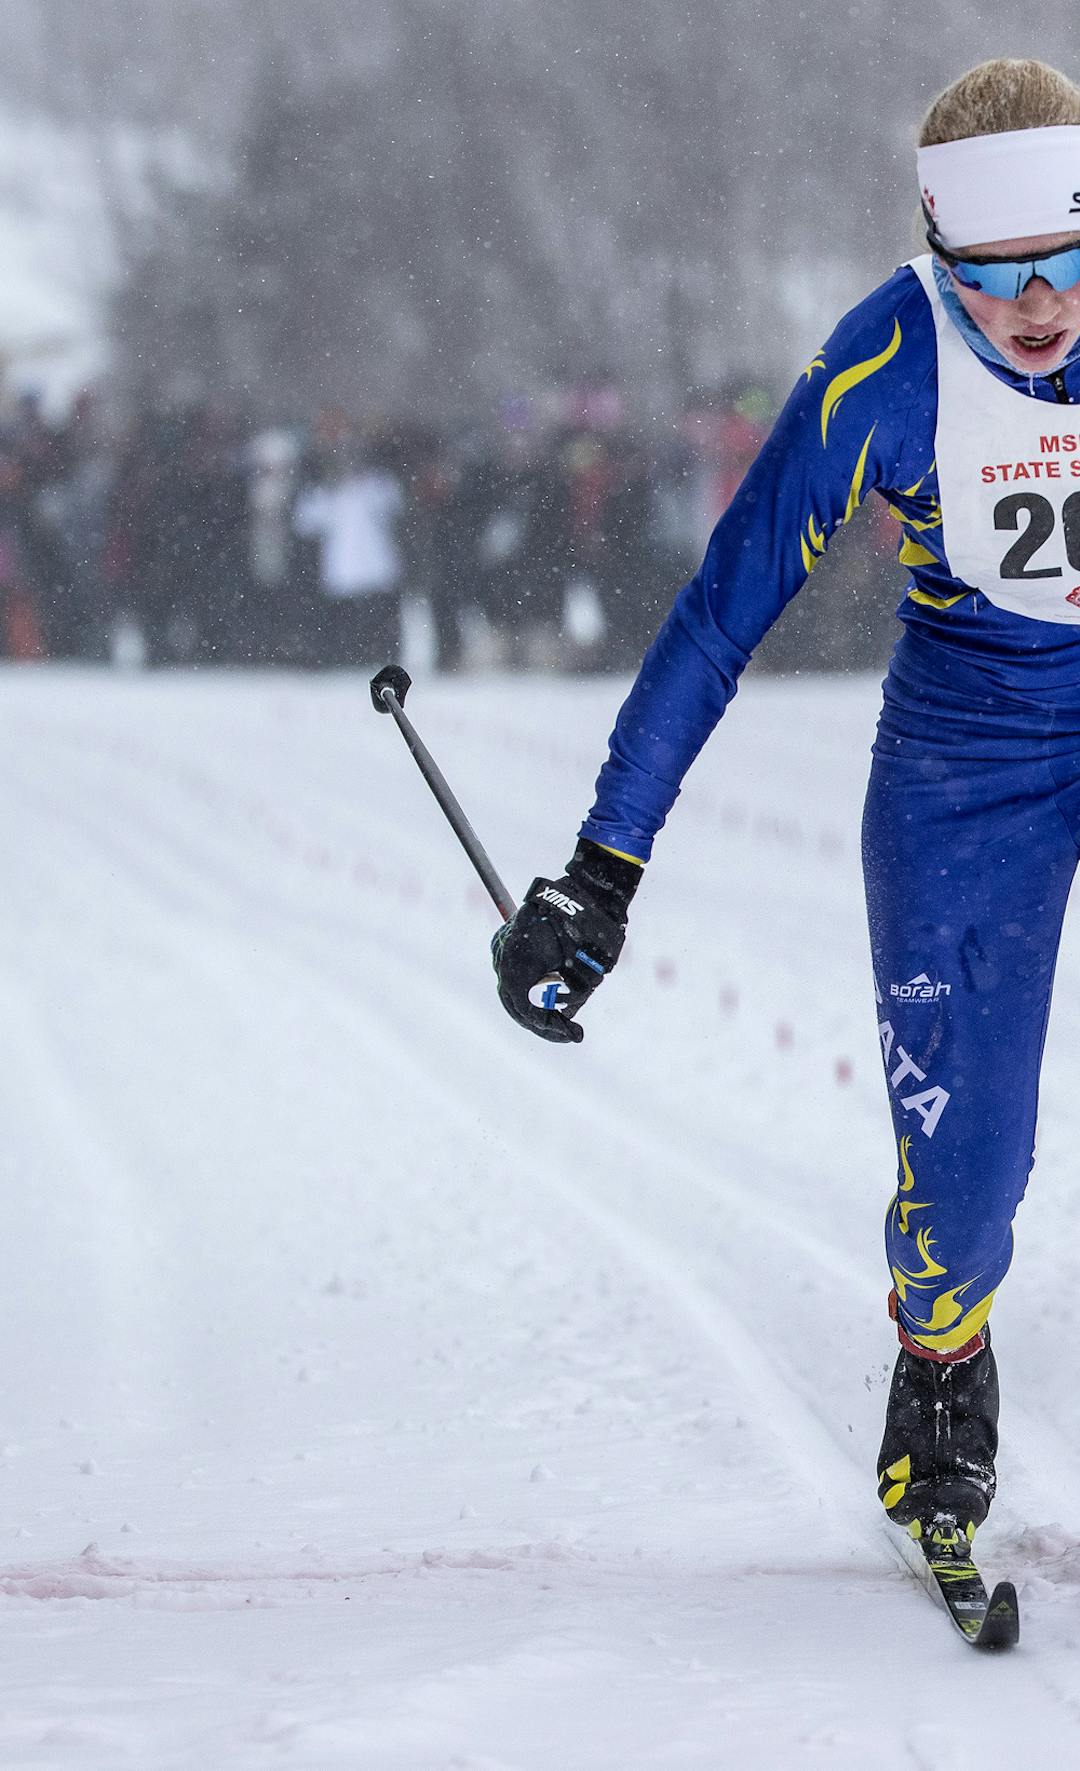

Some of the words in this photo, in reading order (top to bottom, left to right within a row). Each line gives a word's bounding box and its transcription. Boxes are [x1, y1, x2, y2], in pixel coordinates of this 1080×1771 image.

[981, 461, 1061, 483] STATE
[536, 886, 584, 917] SWIX
[875, 982, 951, 1138] ATA
